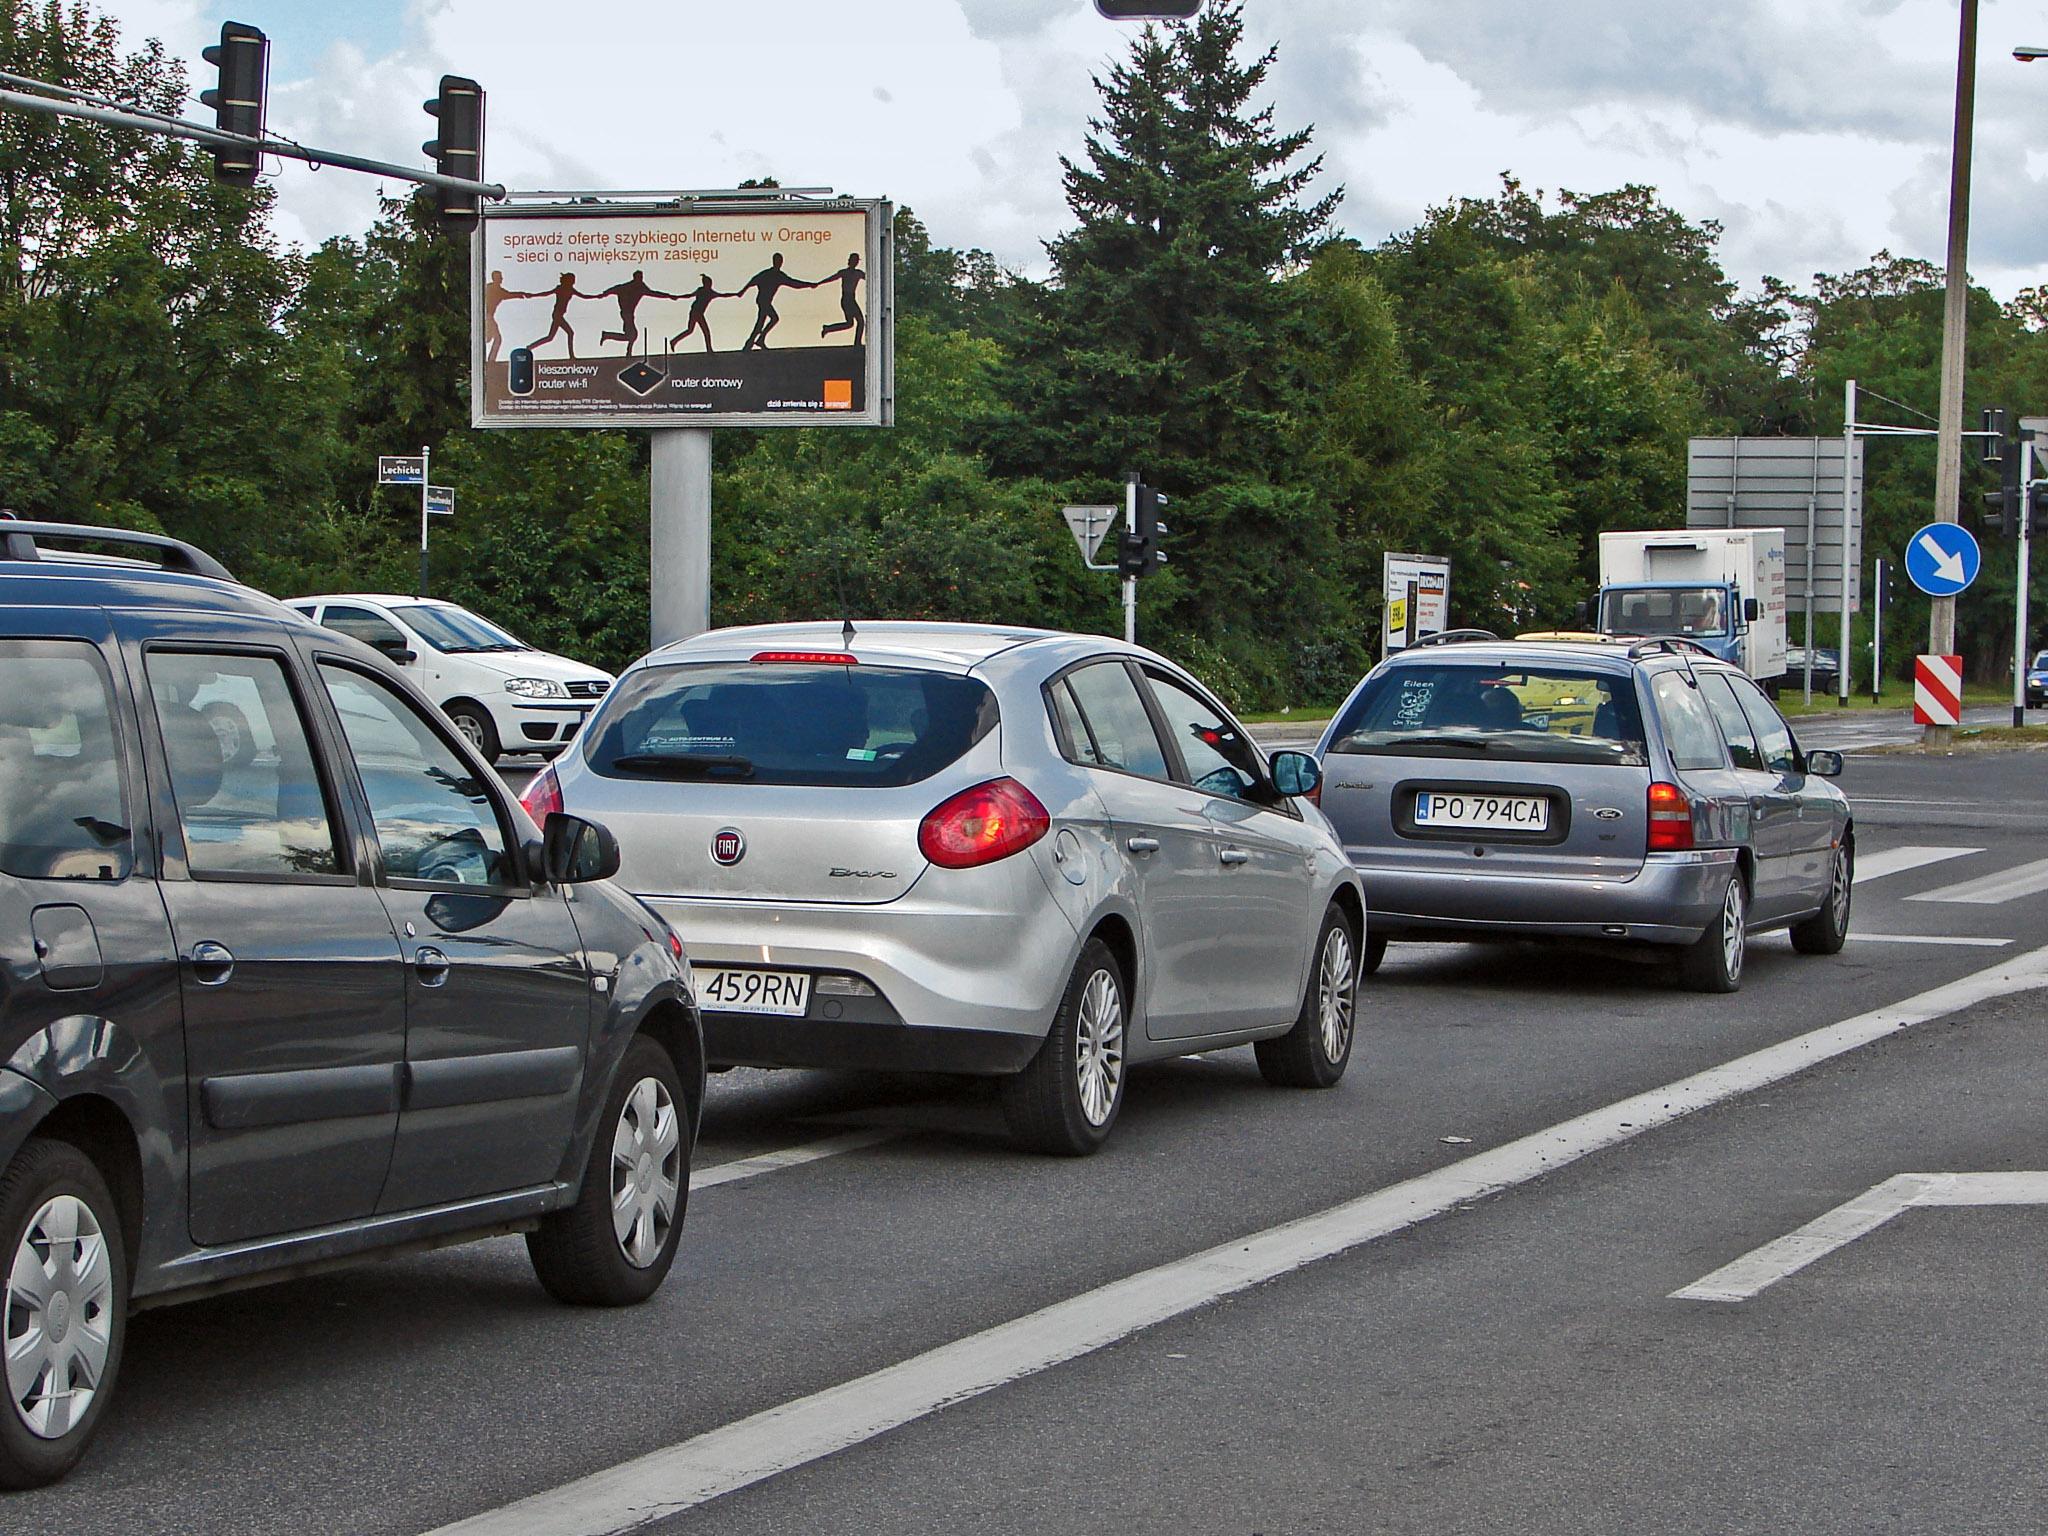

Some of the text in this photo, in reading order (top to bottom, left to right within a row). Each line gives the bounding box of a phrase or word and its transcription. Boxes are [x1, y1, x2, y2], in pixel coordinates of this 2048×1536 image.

[503, 228, 832, 248] sprawdź ofertę szybkiego Internetu w Orange
[516, 249, 549, 263] sieci
[554, 252, 563, 262] o
[568, 248, 659, 264] największym
[664, 247, 719, 263] zasięgu
[538, 364, 599, 376] kieszonkowy
[538, 378, 588, 389] router wi-fi
[671, 377, 743, 389] router domowy
[382, 465, 421, 475] Lechicka
[1403, 680, 1434, 688] Eileen
[1431, 797, 1541, 823] PO 794CA
[718, 839, 737, 855] FIAT
[706, 972, 804, 1007] 459RN
